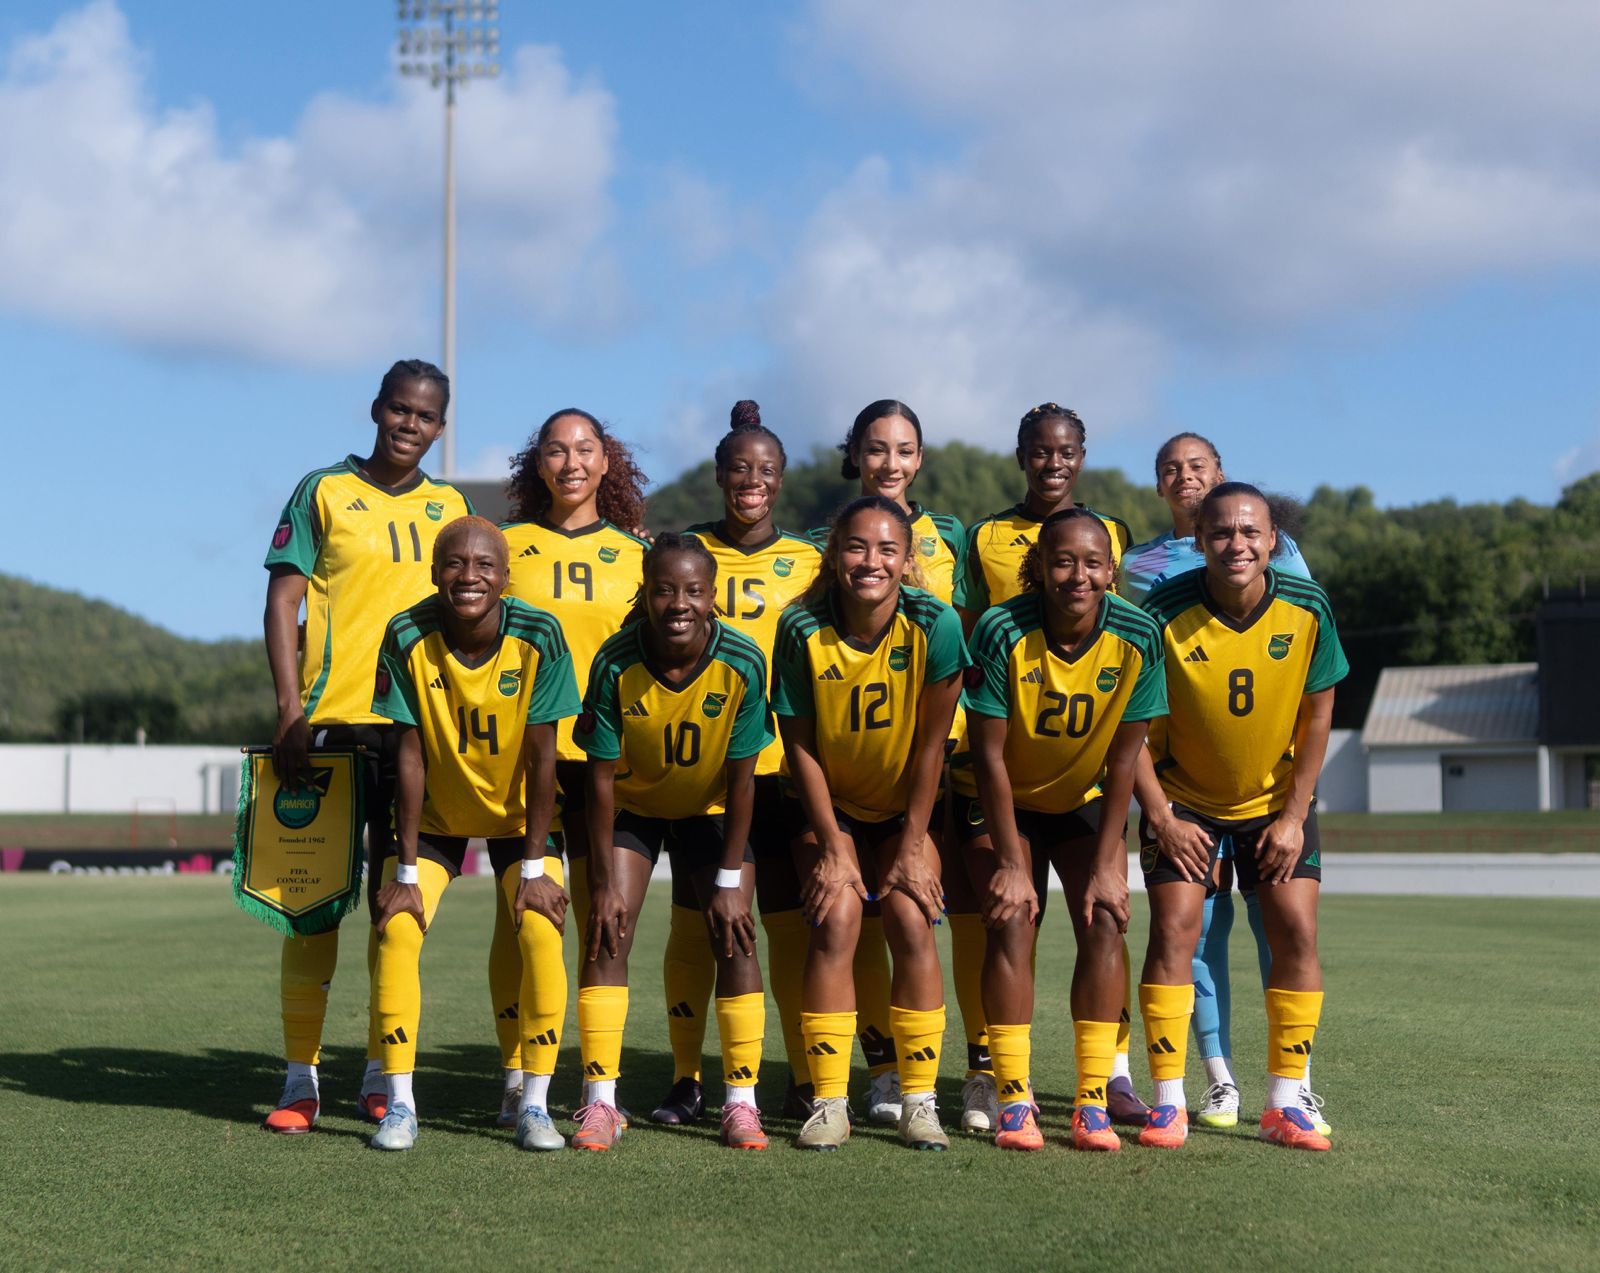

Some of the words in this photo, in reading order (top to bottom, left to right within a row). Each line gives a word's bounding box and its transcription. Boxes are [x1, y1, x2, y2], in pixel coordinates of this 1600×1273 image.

[388, 521, 422, 563] 11
[553, 560, 593, 601] 19
[727, 576, 766, 620] 15
[851, 682, 891, 732] 12
[1034, 690, 1095, 738] 20
[1228, 668, 1254, 717] 8
[457, 706, 499, 755] 14
[663, 721, 701, 767] 10
[278, 799, 315, 809] JAMAICA
[278, 836, 306, 844] Founded
[276, 877, 321, 885] CONCACAF
[289, 886, 307, 894] CFU
